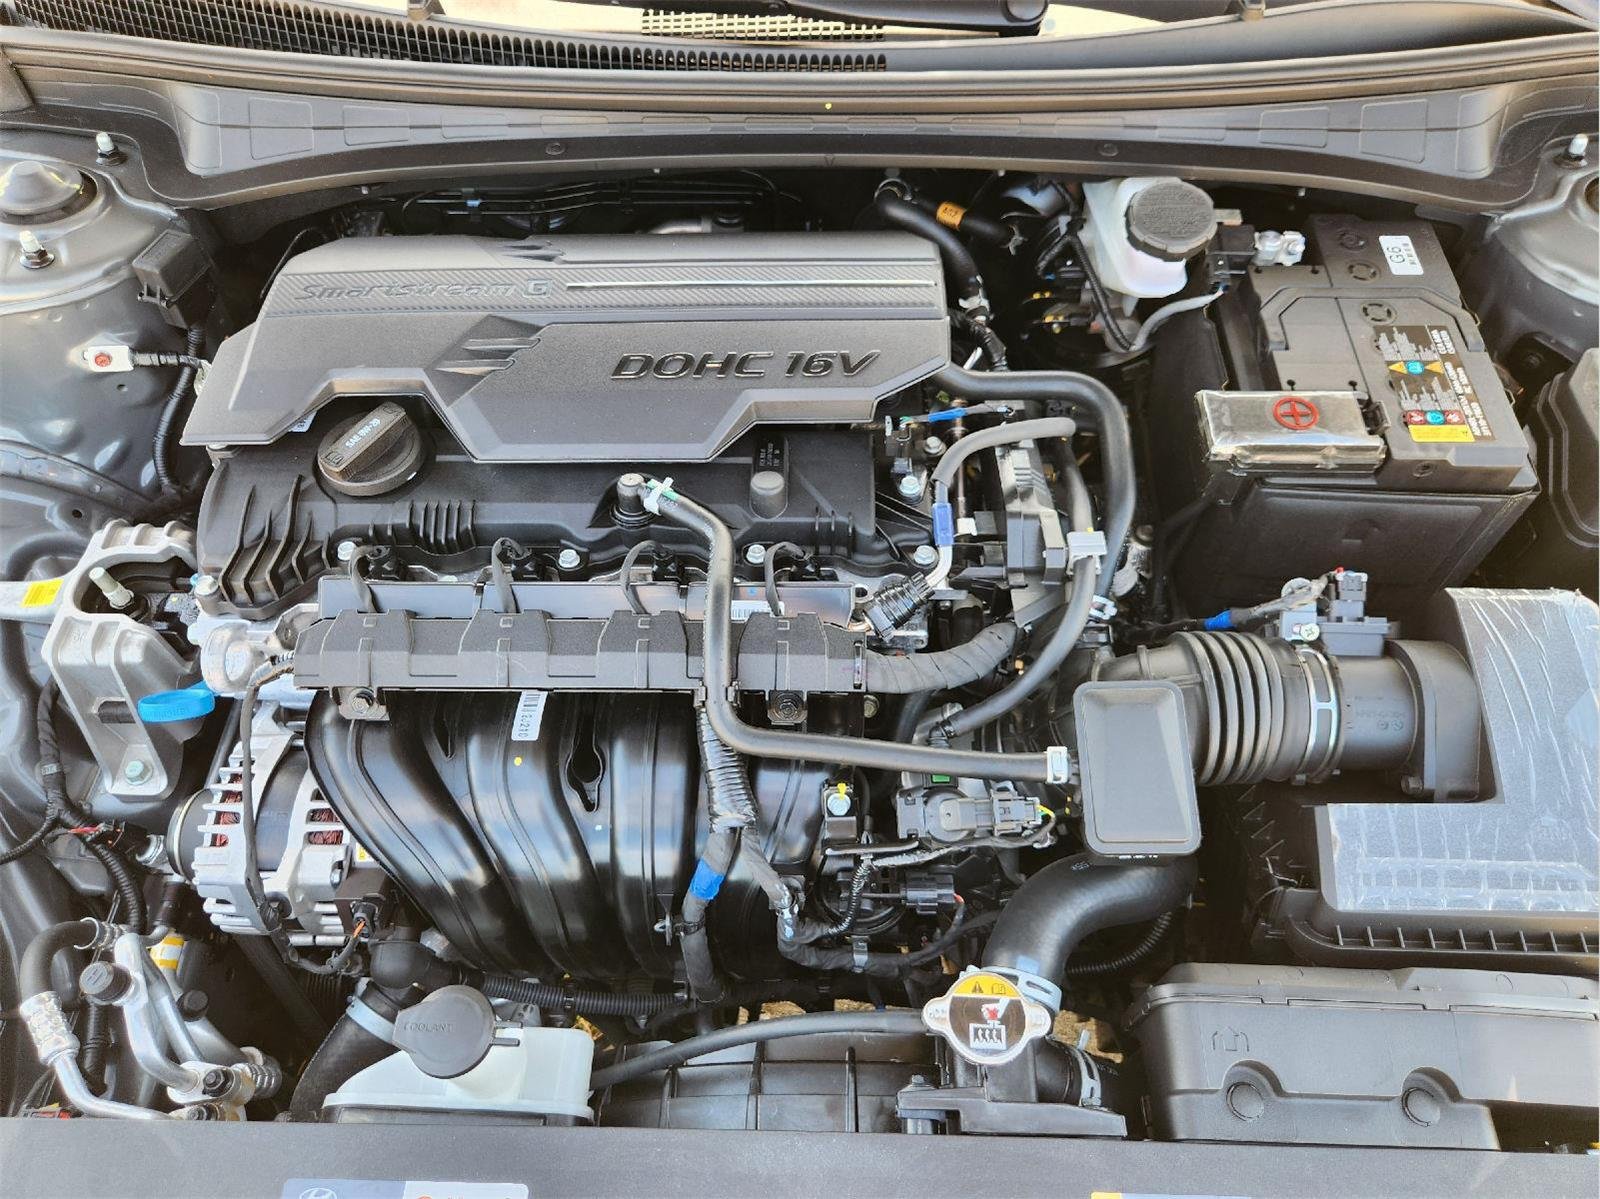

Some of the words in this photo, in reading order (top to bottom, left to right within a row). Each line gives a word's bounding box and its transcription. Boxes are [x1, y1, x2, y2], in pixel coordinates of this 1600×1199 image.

[295, 282, 516, 300] Smartstream
[522, 278, 554, 301] G
[611, 350, 774, 380] DOHC
[784, 349, 881, 379] 16V
[404, 1022, 454, 1033] COOLANT
